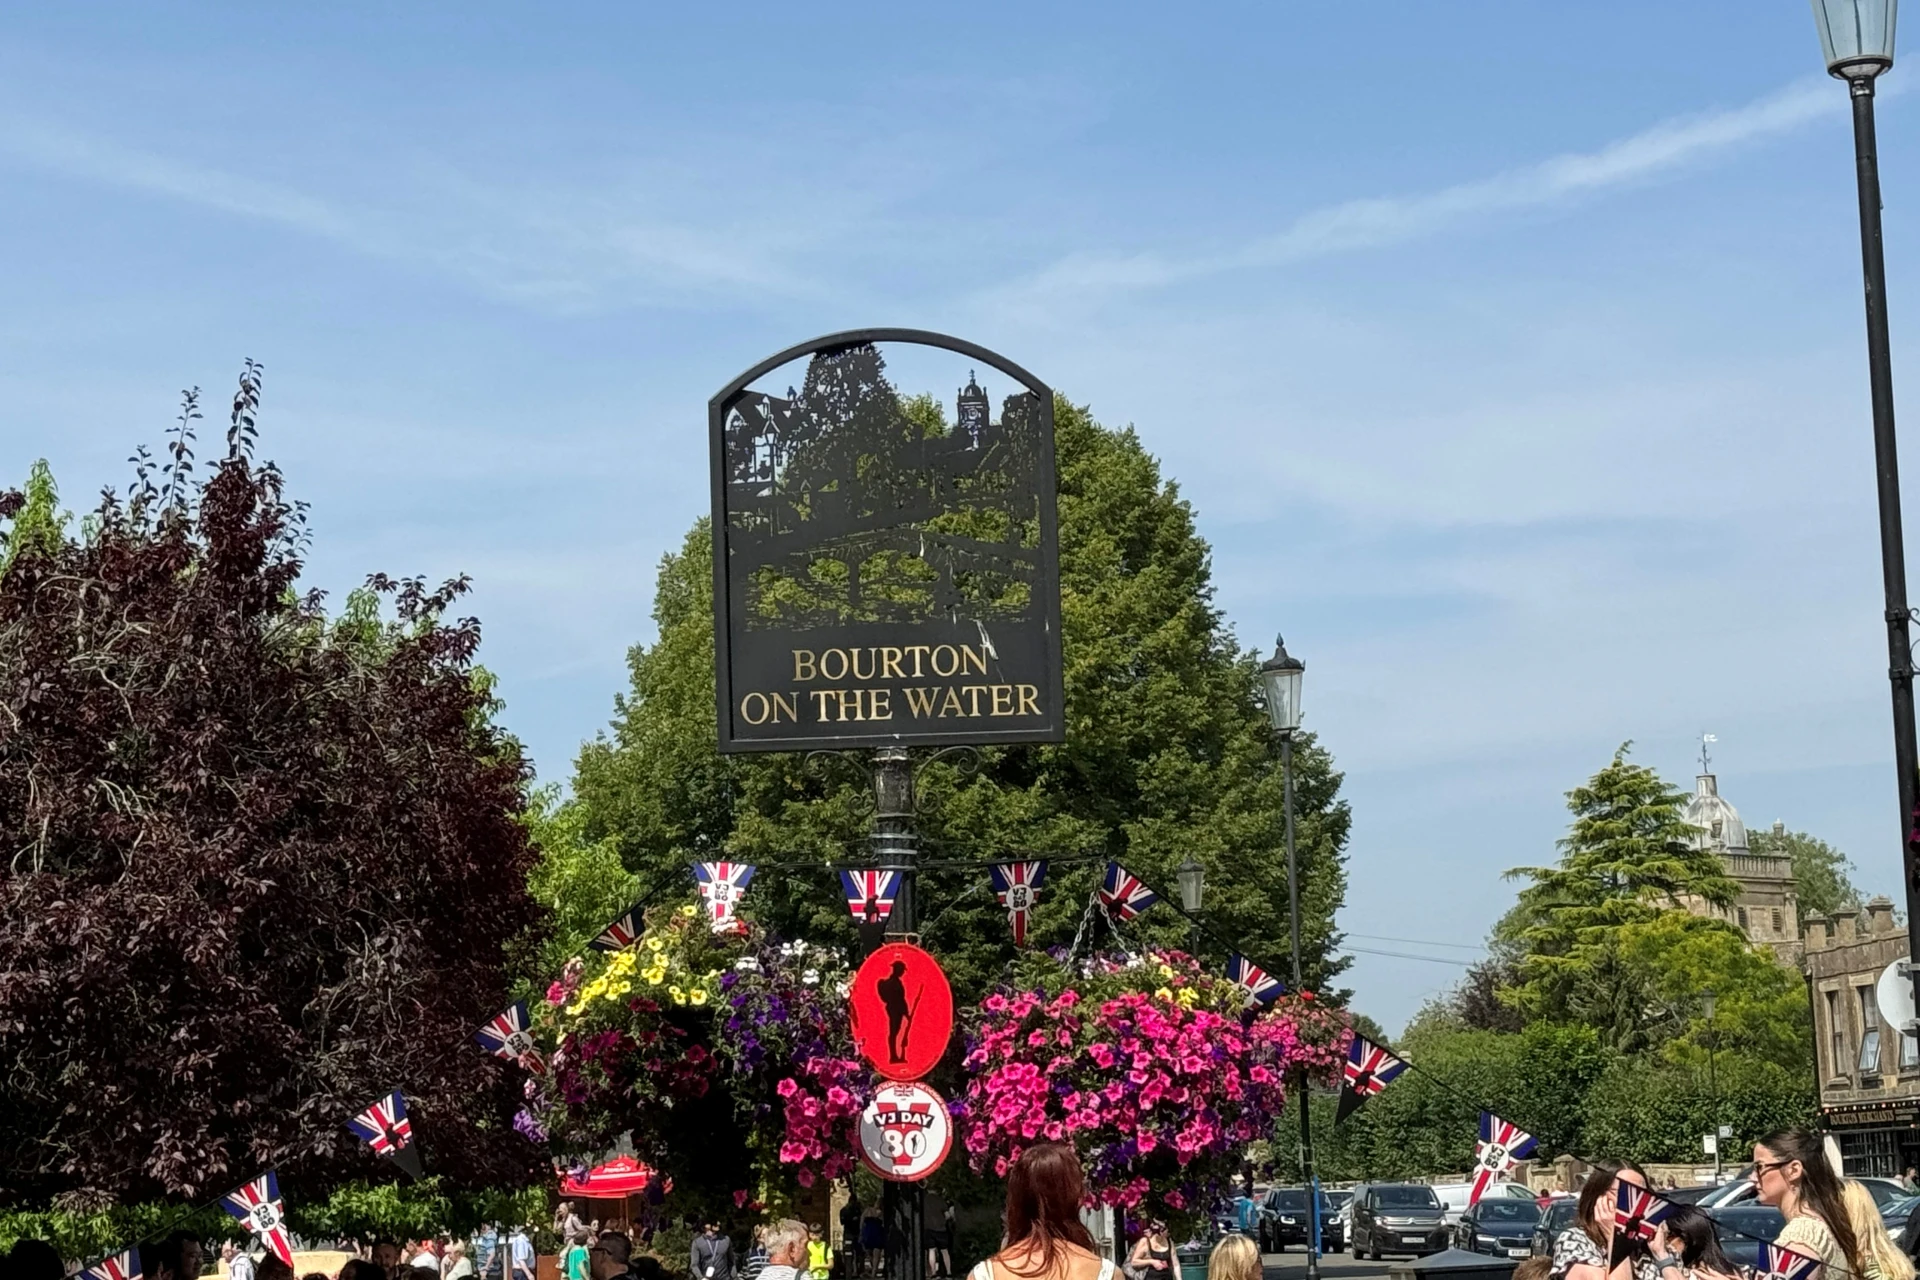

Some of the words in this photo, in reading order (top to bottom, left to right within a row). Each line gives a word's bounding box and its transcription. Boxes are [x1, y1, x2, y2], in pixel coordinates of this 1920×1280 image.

[791, 644, 989, 682] BOURTON
[740, 692, 799, 725] ON
[810, 689, 893, 722] THE
[902, 684, 1042, 719] WATER
[715, 883, 729, 891] VJ
[1013, 887, 1027, 895] VJ
[875, 1111, 897, 1125] VJ
[901, 1112, 932, 1126] DAY
[880, 1129, 927, 1159] 80
[1491, 1145, 1505, 1157] VJ
[253, 1205, 268, 1217] VJ
